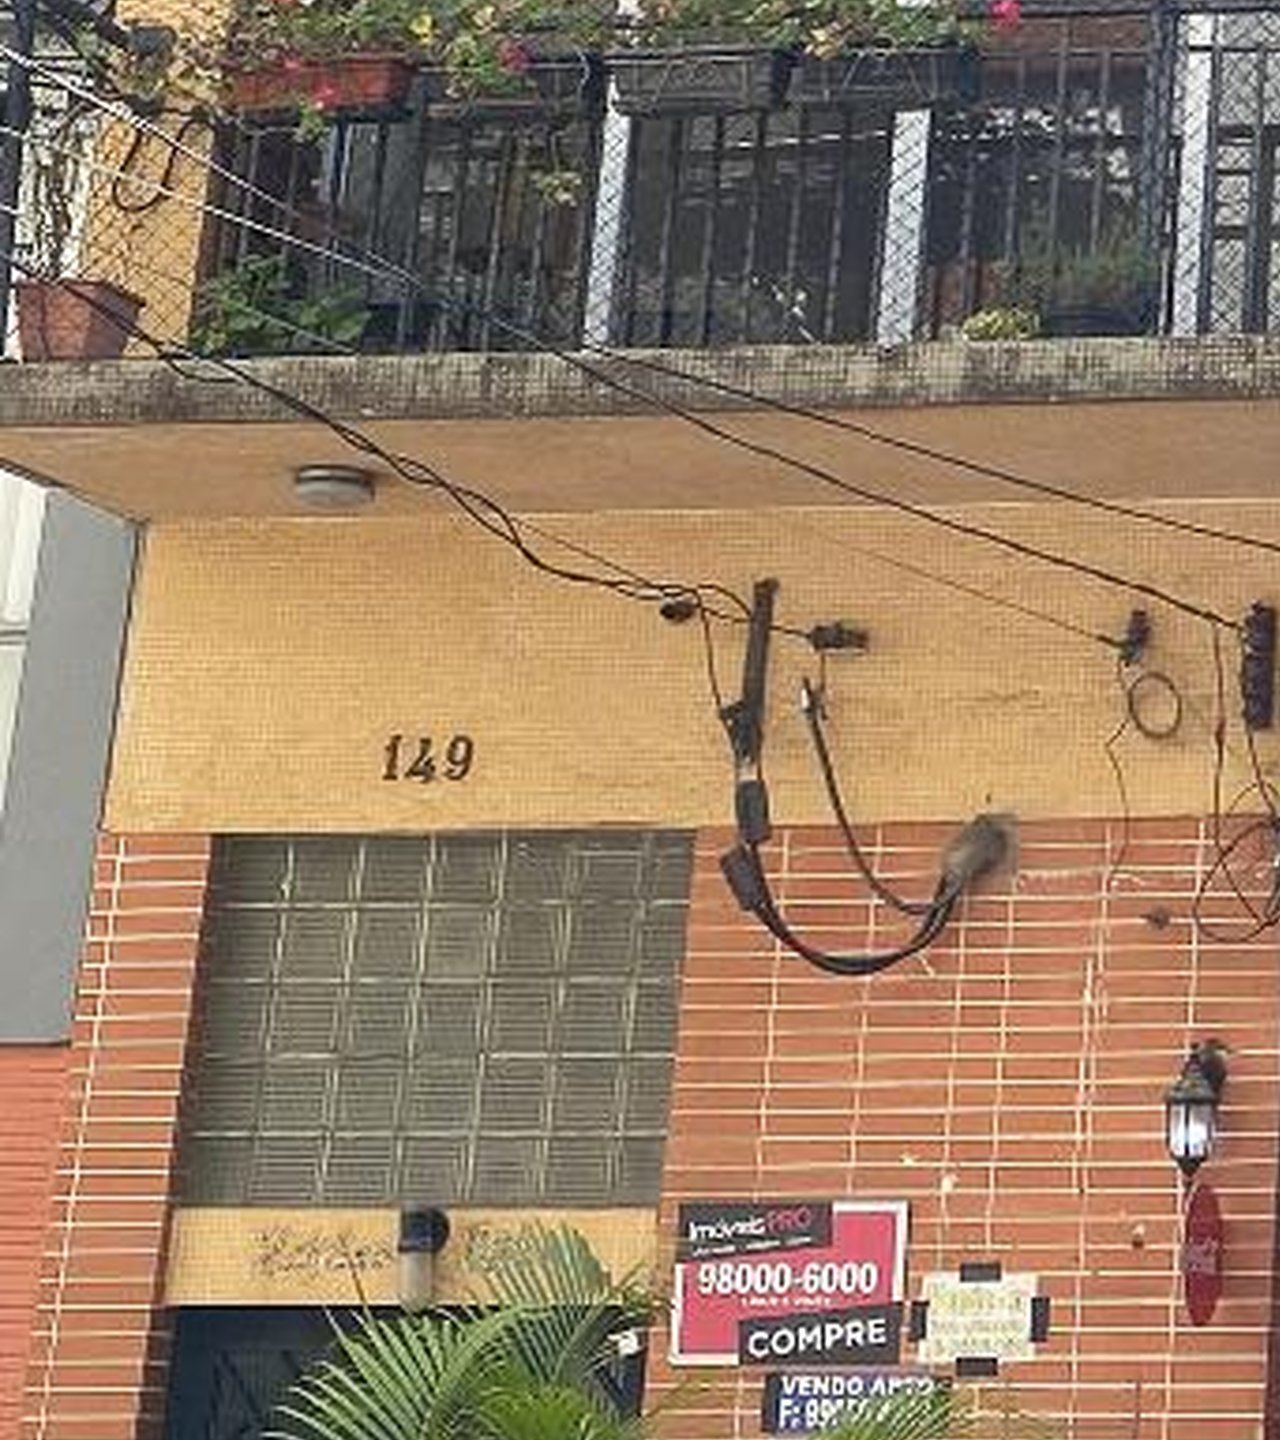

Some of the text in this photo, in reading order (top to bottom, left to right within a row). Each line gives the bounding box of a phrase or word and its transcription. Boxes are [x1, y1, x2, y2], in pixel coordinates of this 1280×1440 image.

[382, 734, 474, 783] 149
[698, 1262, 879, 1295] 98000-6000
[749, 1318, 887, 1357] COMPRE
[781, 1375, 864, 1396] VENDO
